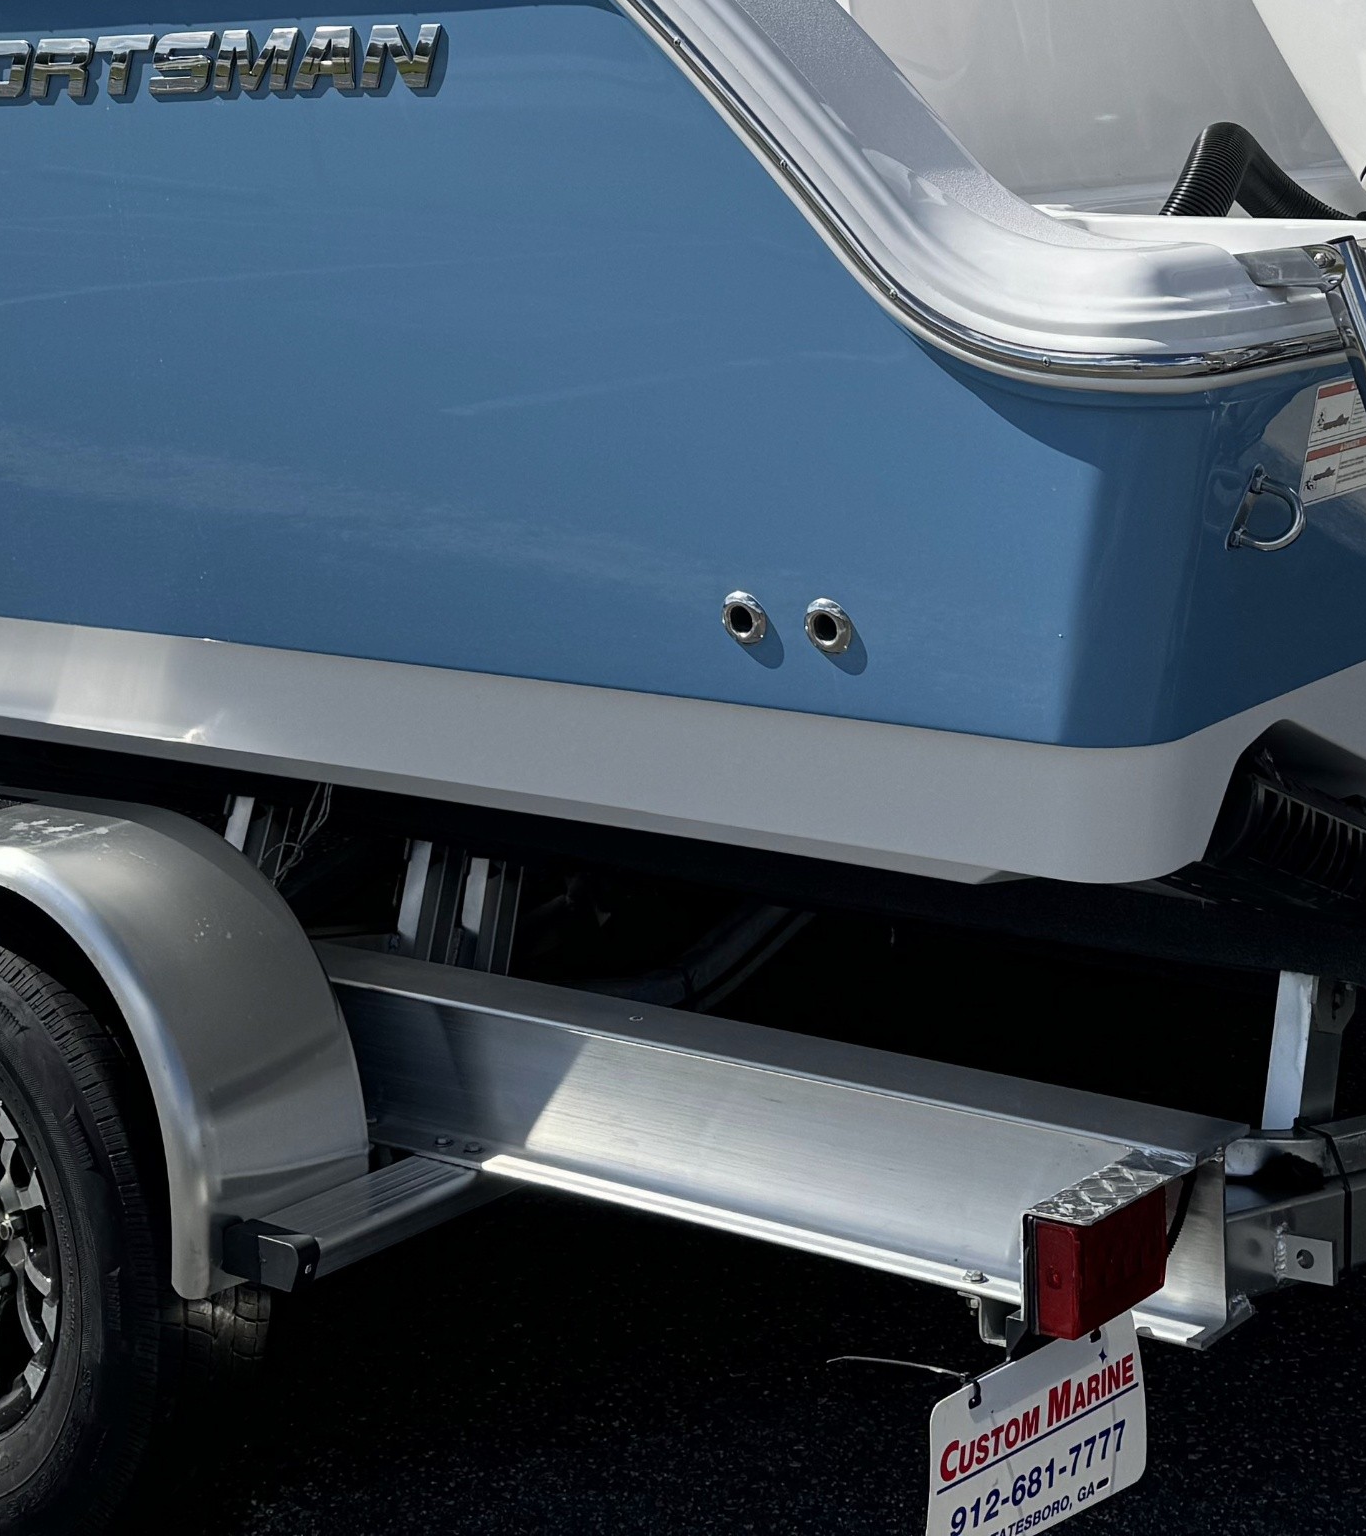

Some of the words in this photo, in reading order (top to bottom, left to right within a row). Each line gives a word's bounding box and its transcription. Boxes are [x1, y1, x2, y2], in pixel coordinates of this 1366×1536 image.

[939, 1404, 1041, 1483] CUSTOM
[1046, 1352, 1135, 1429] MARINE
[949, 1419, 1127, 1536] 912-681-7777
[1077, 1481, 1095, 1502] GA
